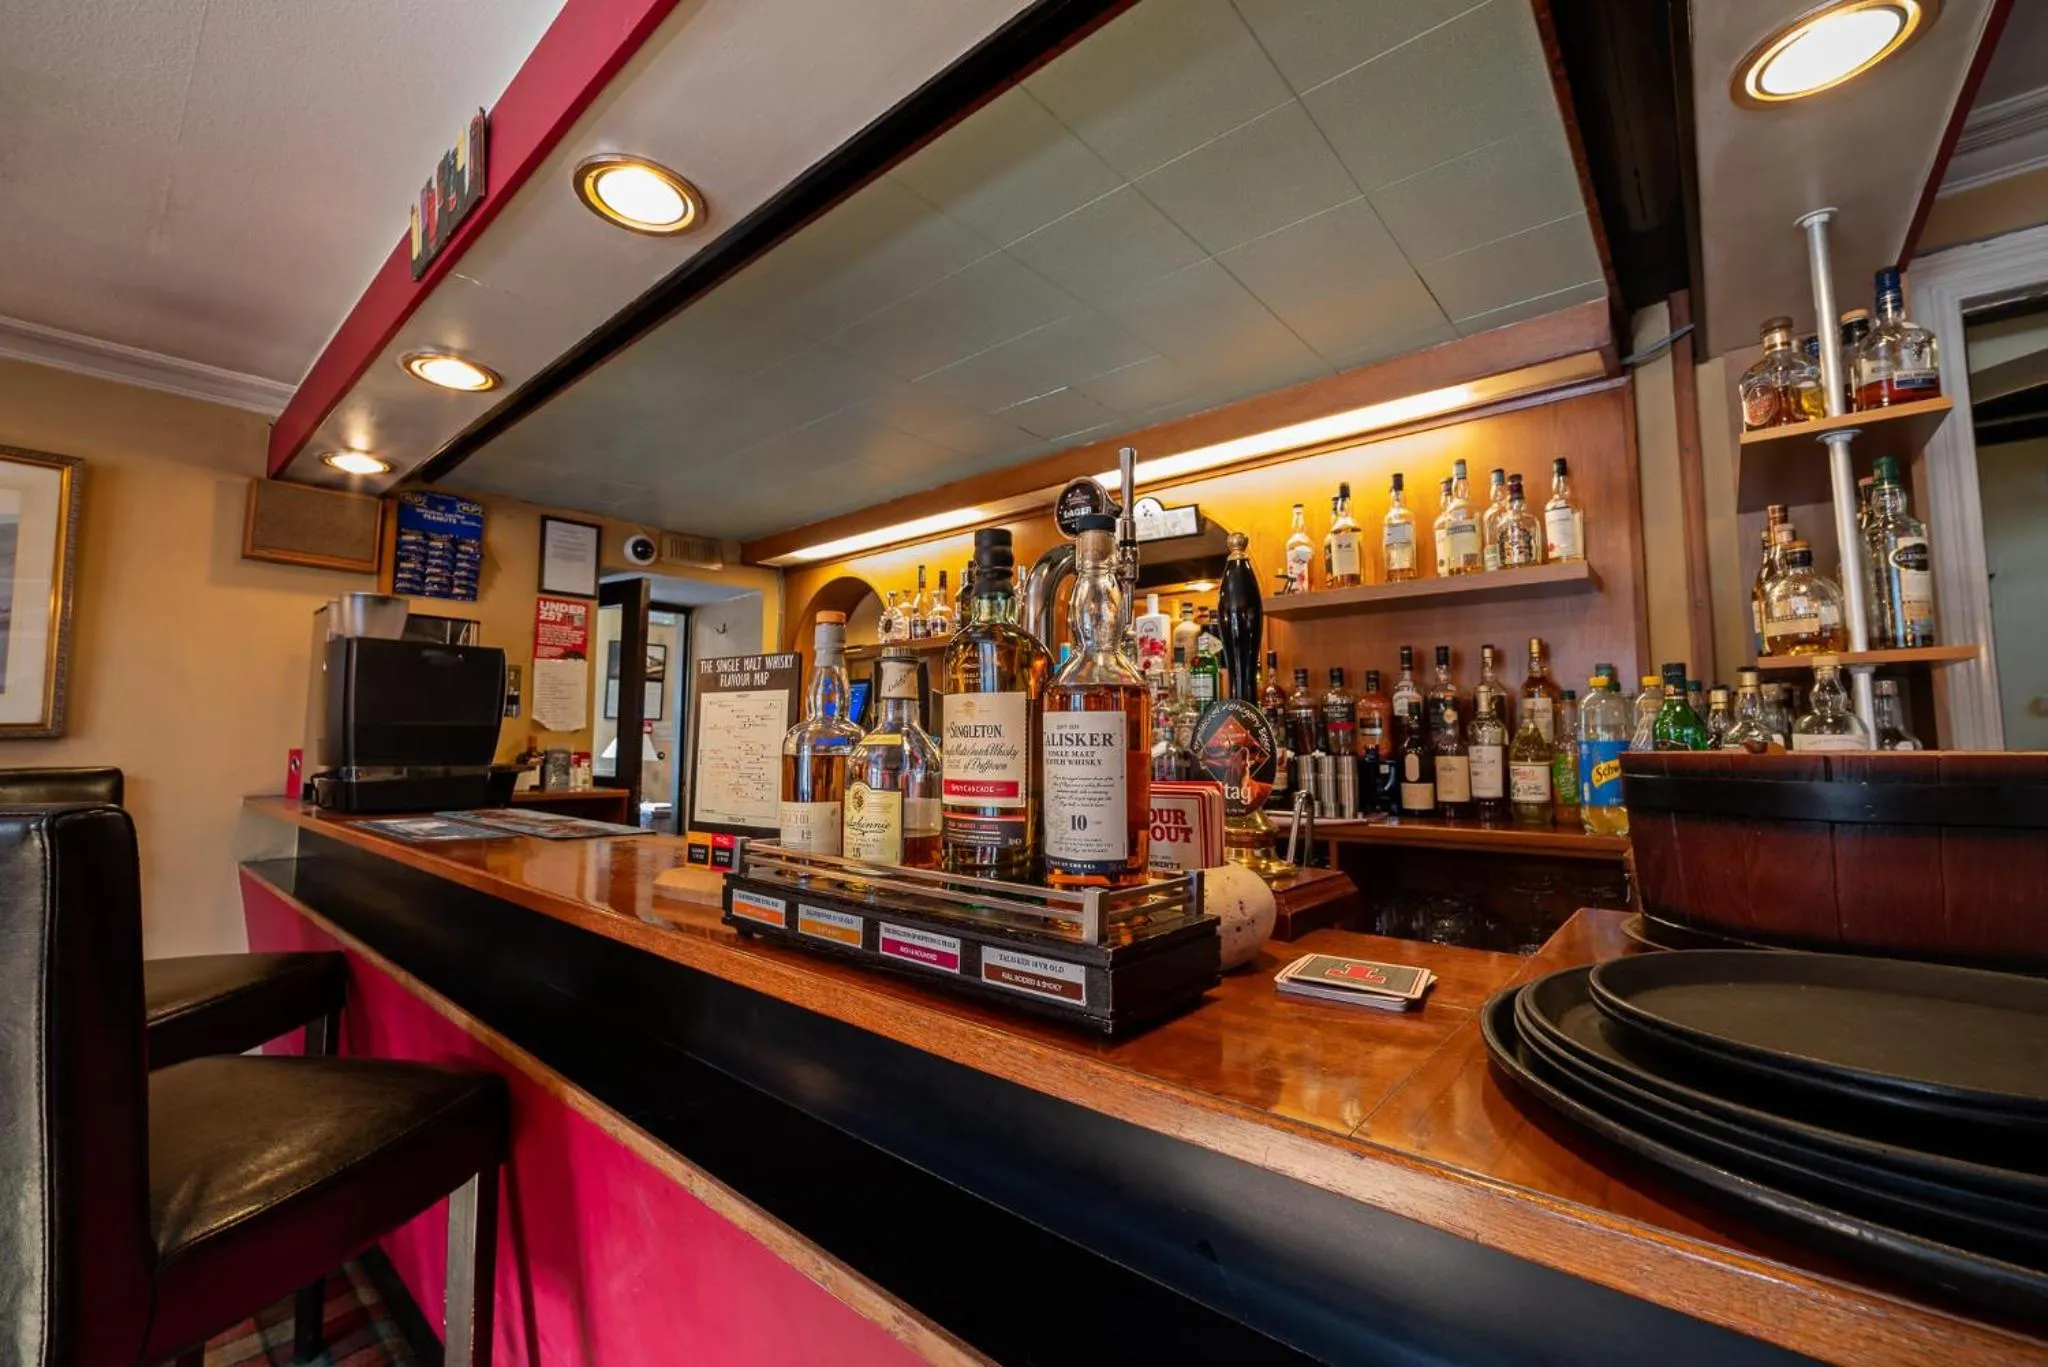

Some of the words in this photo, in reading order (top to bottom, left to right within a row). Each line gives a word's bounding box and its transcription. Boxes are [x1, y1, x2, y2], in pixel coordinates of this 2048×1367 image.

[540, 600, 586, 615] UNDER
[540, 610, 563, 622] 25?
[701, 660, 714, 674] THE
[716, 658, 740, 672] SINGLE
[743, 657, 762, 671] MALT
[765, 655, 794, 670] WHISKY
[720, 673, 751, 687] FLAVOUR
[753, 672, 770, 686] MAP
[950, 721, 1003, 738] SINGLETON
[1222, 782, 1252, 805] tag
[1070, 814, 1088, 831] 10
[1149, 808, 1188, 826] OUR
[1150, 825, 1193, 843] OUT
[1049, 964, 1065, 974] OLD
